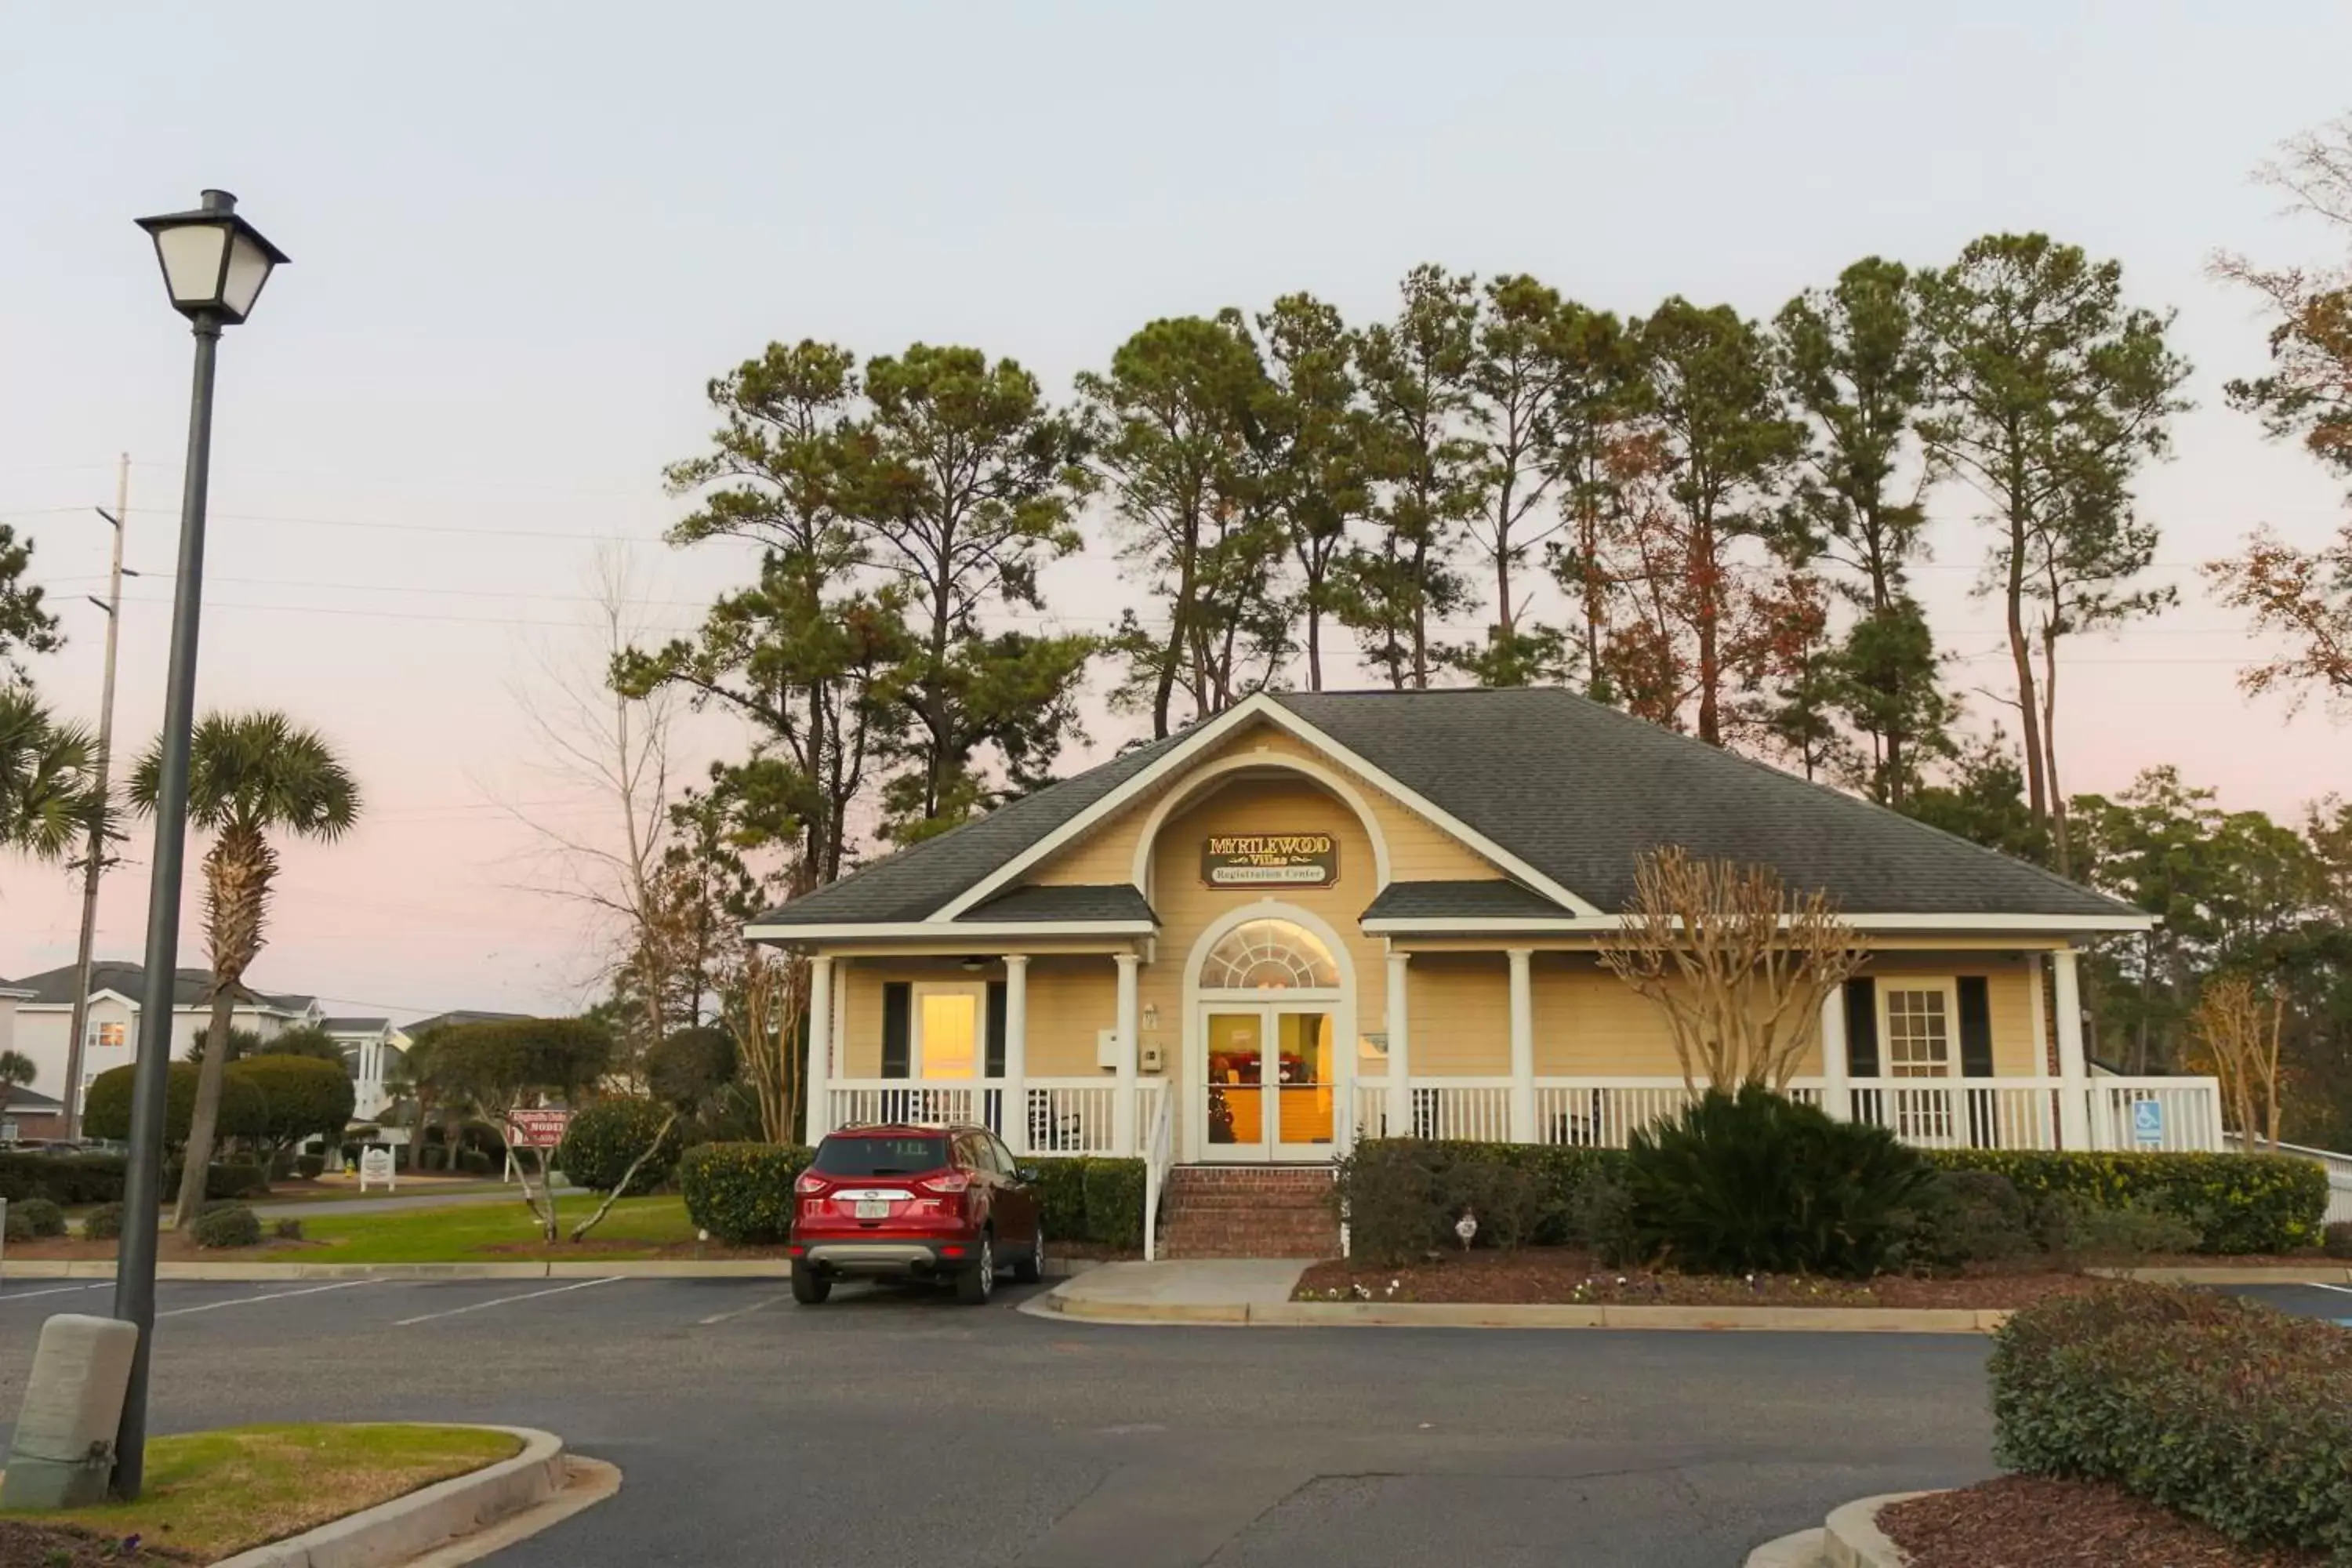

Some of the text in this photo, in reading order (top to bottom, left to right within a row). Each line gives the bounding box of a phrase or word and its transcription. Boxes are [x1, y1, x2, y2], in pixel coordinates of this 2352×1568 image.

[1210, 837, 1330, 855] MYRTLEWOOD
[1217, 868, 1321, 880] Registration Center
